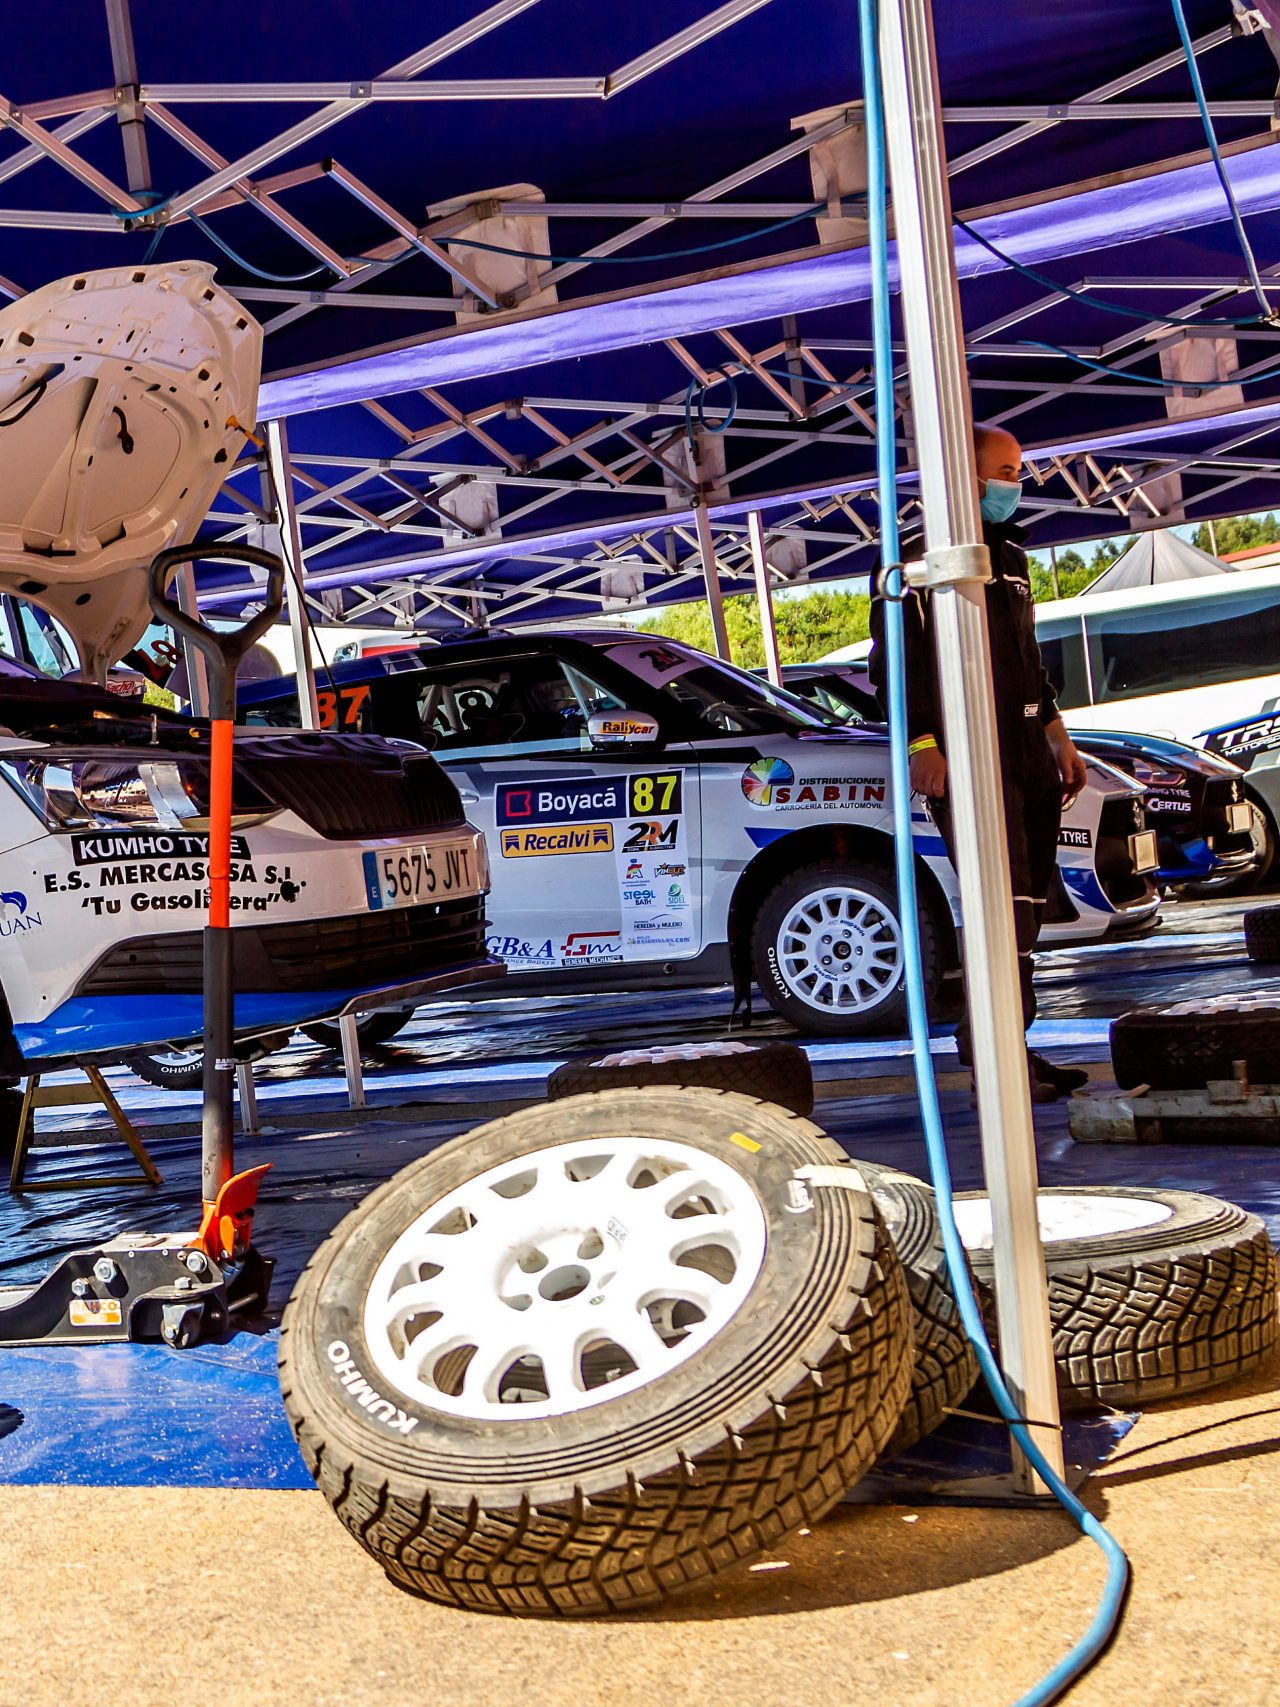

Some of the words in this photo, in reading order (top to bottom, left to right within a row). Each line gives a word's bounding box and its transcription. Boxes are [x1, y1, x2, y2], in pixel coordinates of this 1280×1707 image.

[799, 777, 886, 785] DISTRIBUCIONES
[538, 787, 617, 815] Boyacá
[632, 775, 677, 813] 87
[775, 785, 886, 804] SABIN
[79, 836, 175, 860] KUMHO
[179, 836, 242, 854] TYE
[524, 831, 590, 851] Recalvi
[1061, 830, 1089, 844] TYRE
[44, 870, 91, 893] E.S.
[100, 862, 257, 887] MERCASSA
[383, 853, 437, 898] 5675
[443, 849, 470, 889] JVT
[131, 888, 281, 912] Gasoliera"
[371, 886, 378, 898] E
[767, 946, 792, 999] KUMHO
[327, 1339, 420, 1435] KUMHO
